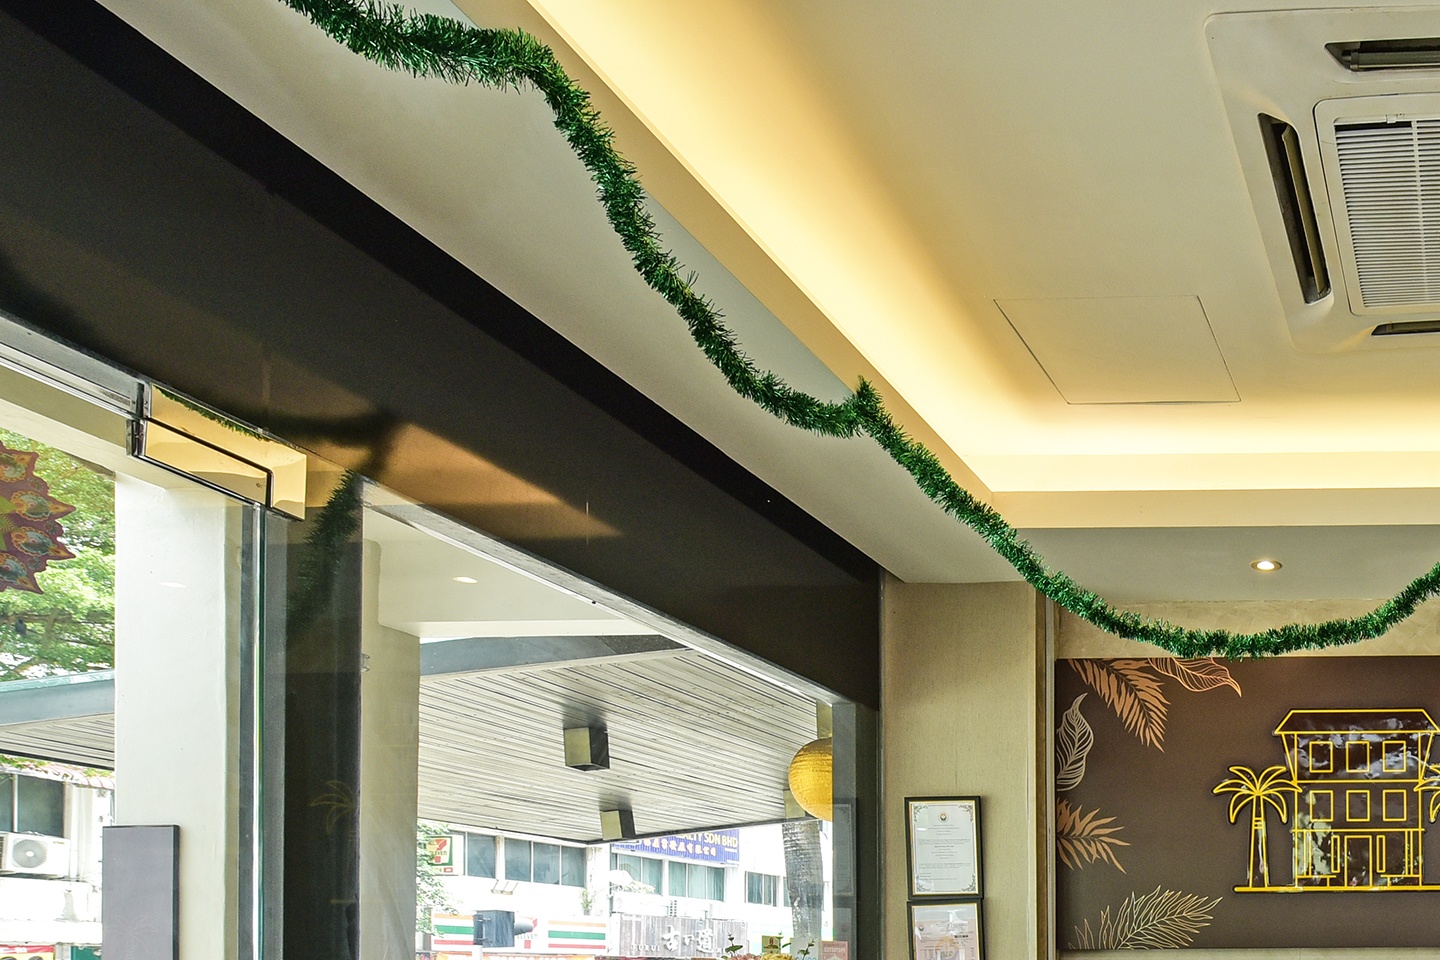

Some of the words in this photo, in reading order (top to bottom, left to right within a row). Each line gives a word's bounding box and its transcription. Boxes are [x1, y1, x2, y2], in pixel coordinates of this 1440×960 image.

[704, 832, 721, 845] SDN
[722, 836, 738, 848] BHD
[632, 944, 661, 953] FURUI
